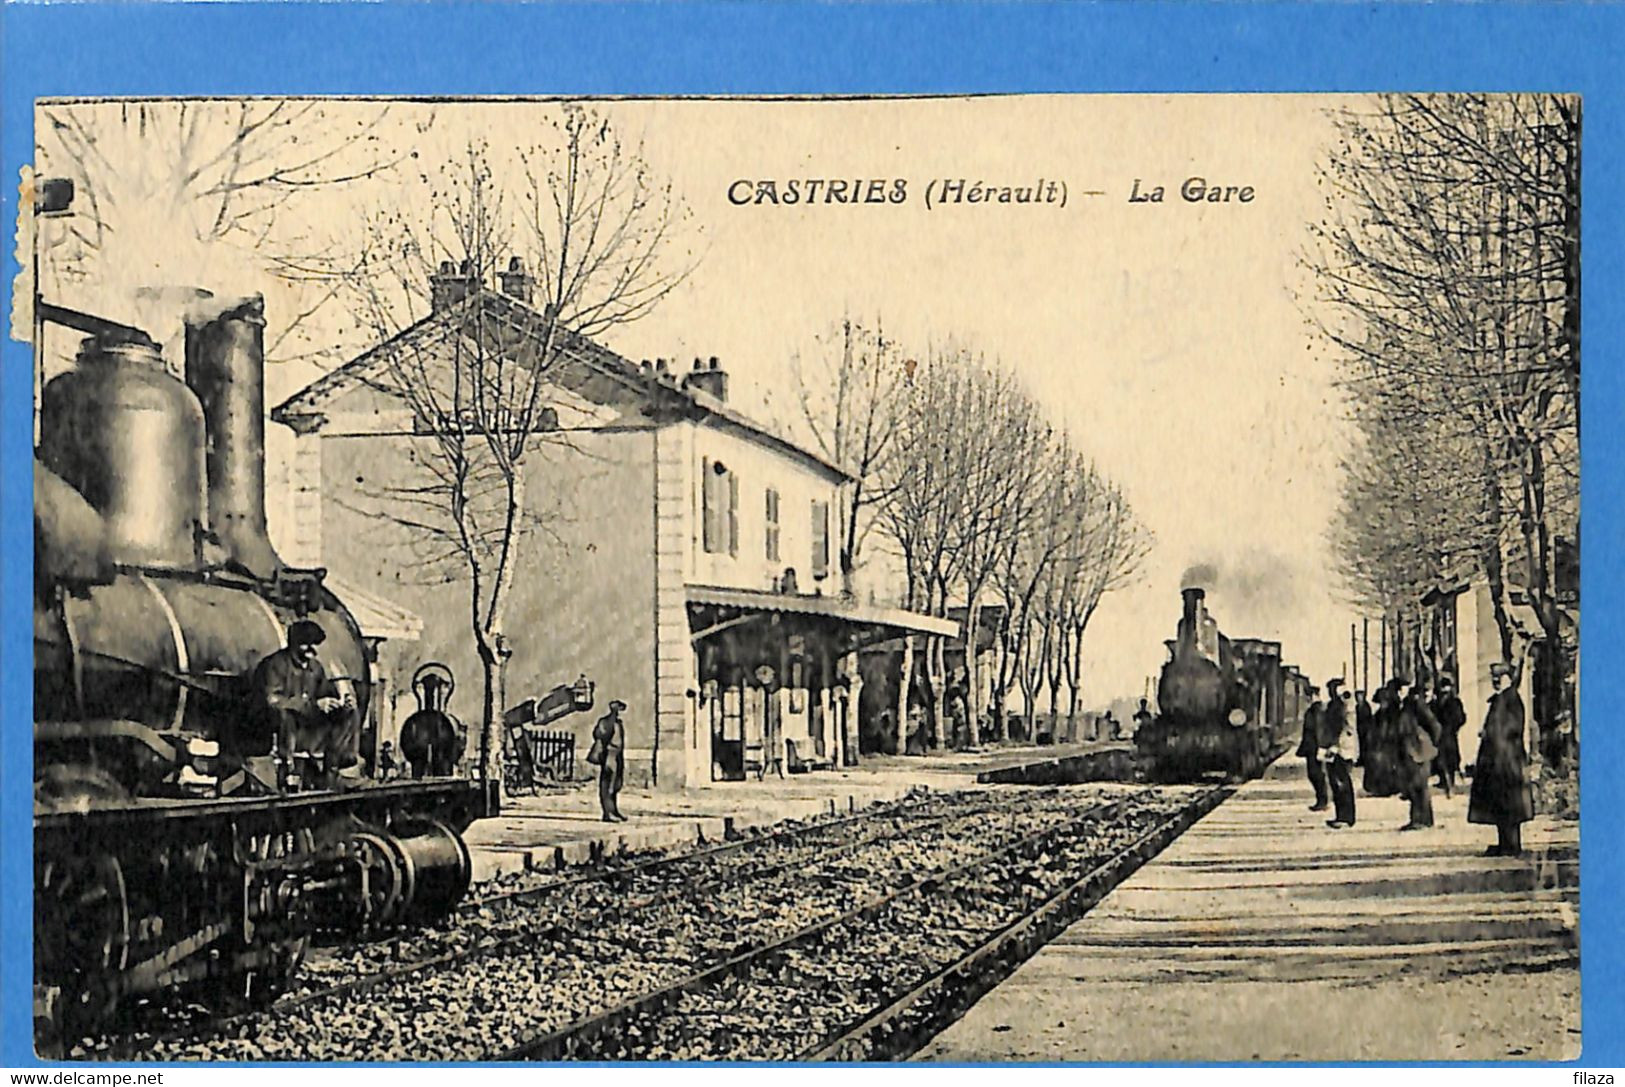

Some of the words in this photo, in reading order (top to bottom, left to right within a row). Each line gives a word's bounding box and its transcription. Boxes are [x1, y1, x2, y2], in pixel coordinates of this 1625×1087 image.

[727, 179, 908, 206] CASTRIES
[924, 179, 1068, 211] (Hérault)
[1128, 180, 1166, 204] La
[1181, 177, 1256, 204] Gare
